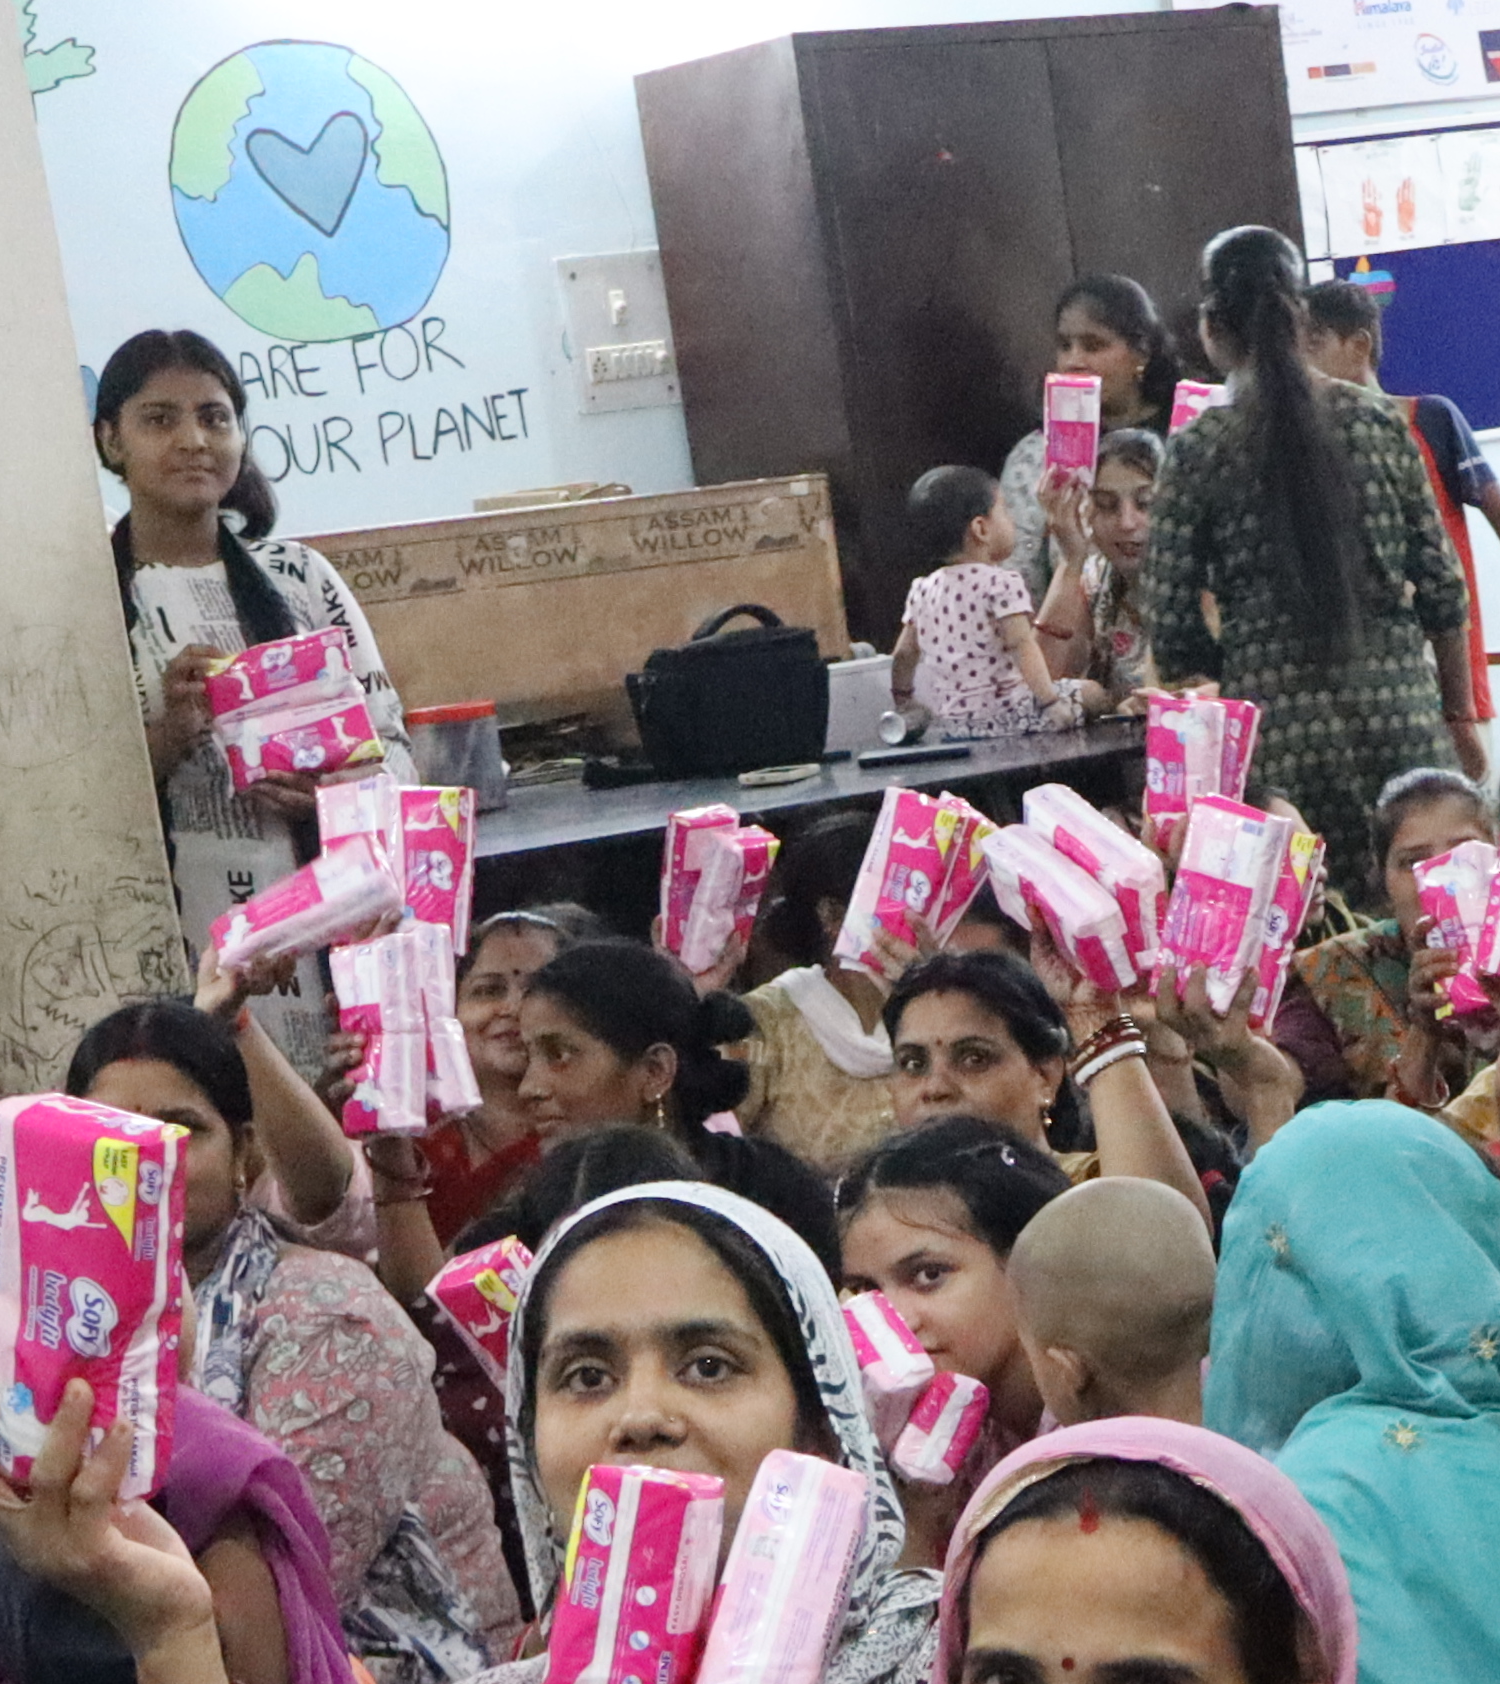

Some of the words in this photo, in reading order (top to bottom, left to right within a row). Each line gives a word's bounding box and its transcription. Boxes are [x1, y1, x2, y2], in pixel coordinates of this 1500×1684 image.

[240, 342, 328, 400] ARE
[352, 317, 466, 395] FOR
[378, 388, 529, 466] PLANET
[631, 525, 749, 555] WILLOW
[646, 506, 734, 532] ASSAM
[39, 1269, 68, 1350] bodyfit
